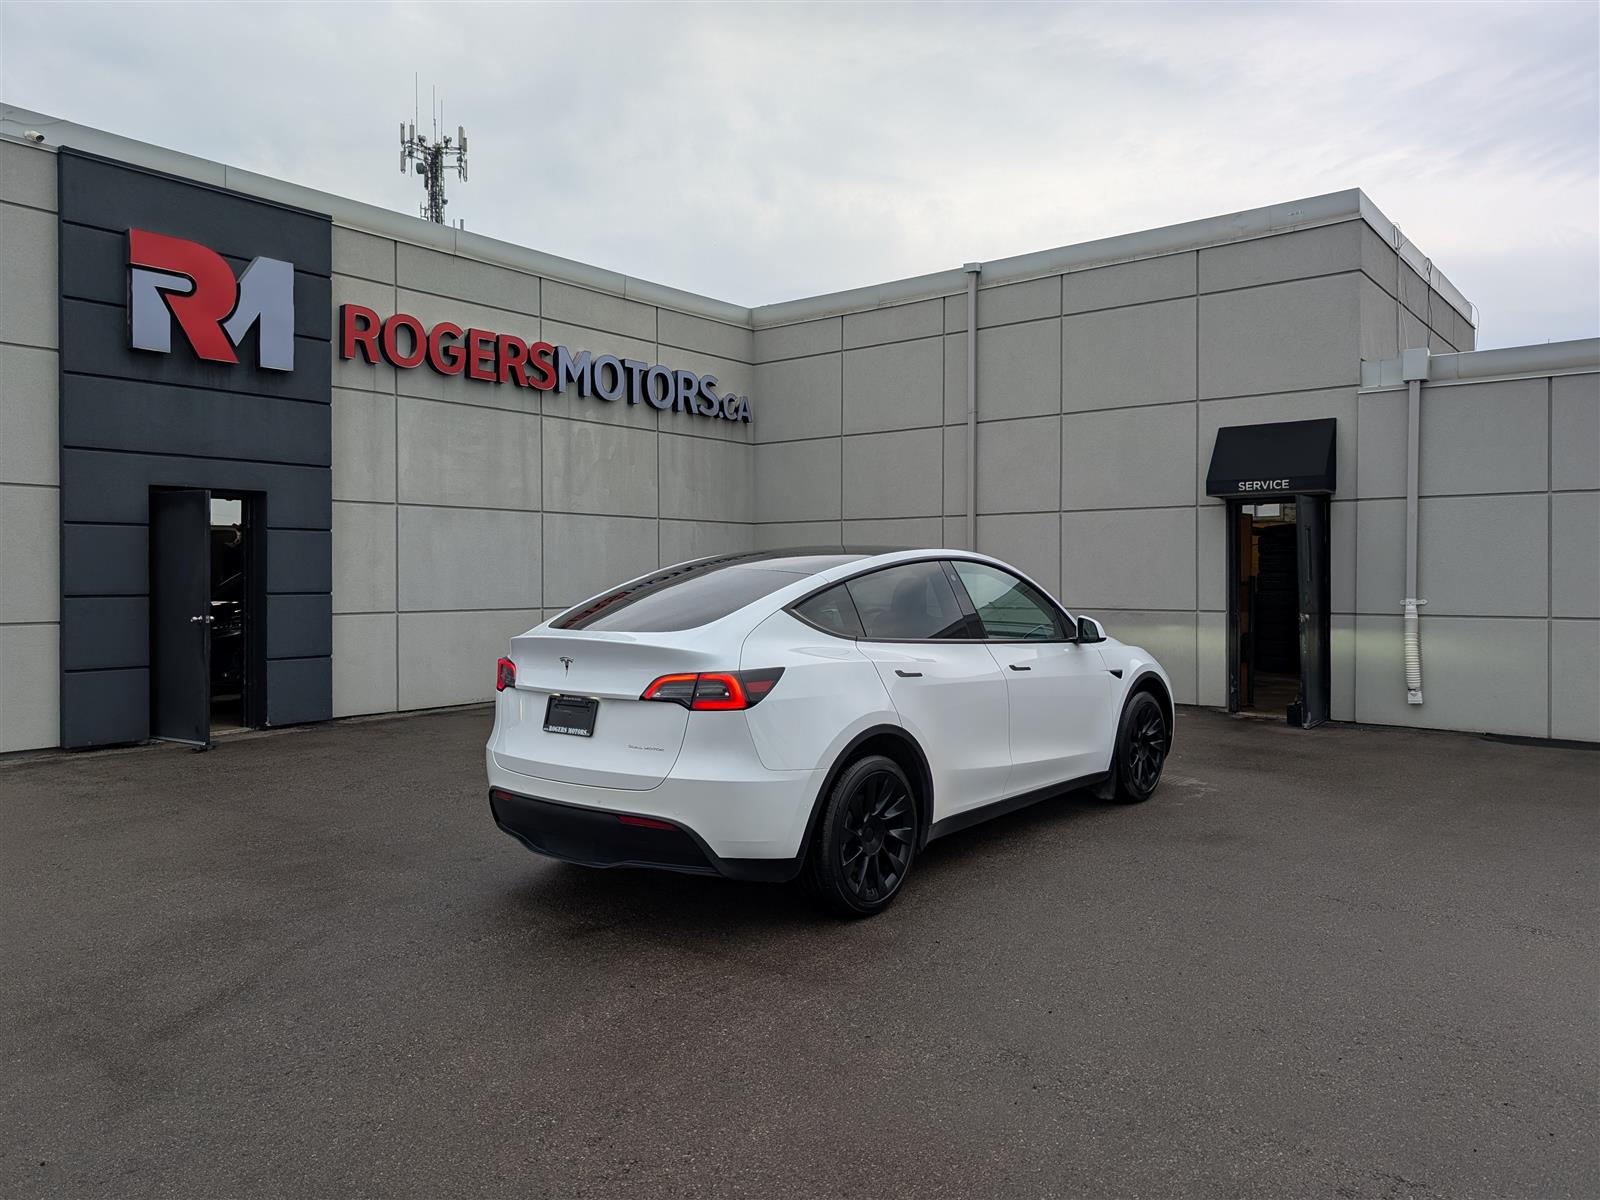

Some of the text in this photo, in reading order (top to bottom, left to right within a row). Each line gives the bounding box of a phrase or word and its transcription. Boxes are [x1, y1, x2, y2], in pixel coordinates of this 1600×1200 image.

[127, 227, 294, 371] RM
[1238, 479, 1290, 491] SERVICE
[548, 725, 567, 733] ROGERS
[567, 727, 588, 736] MOTORS
